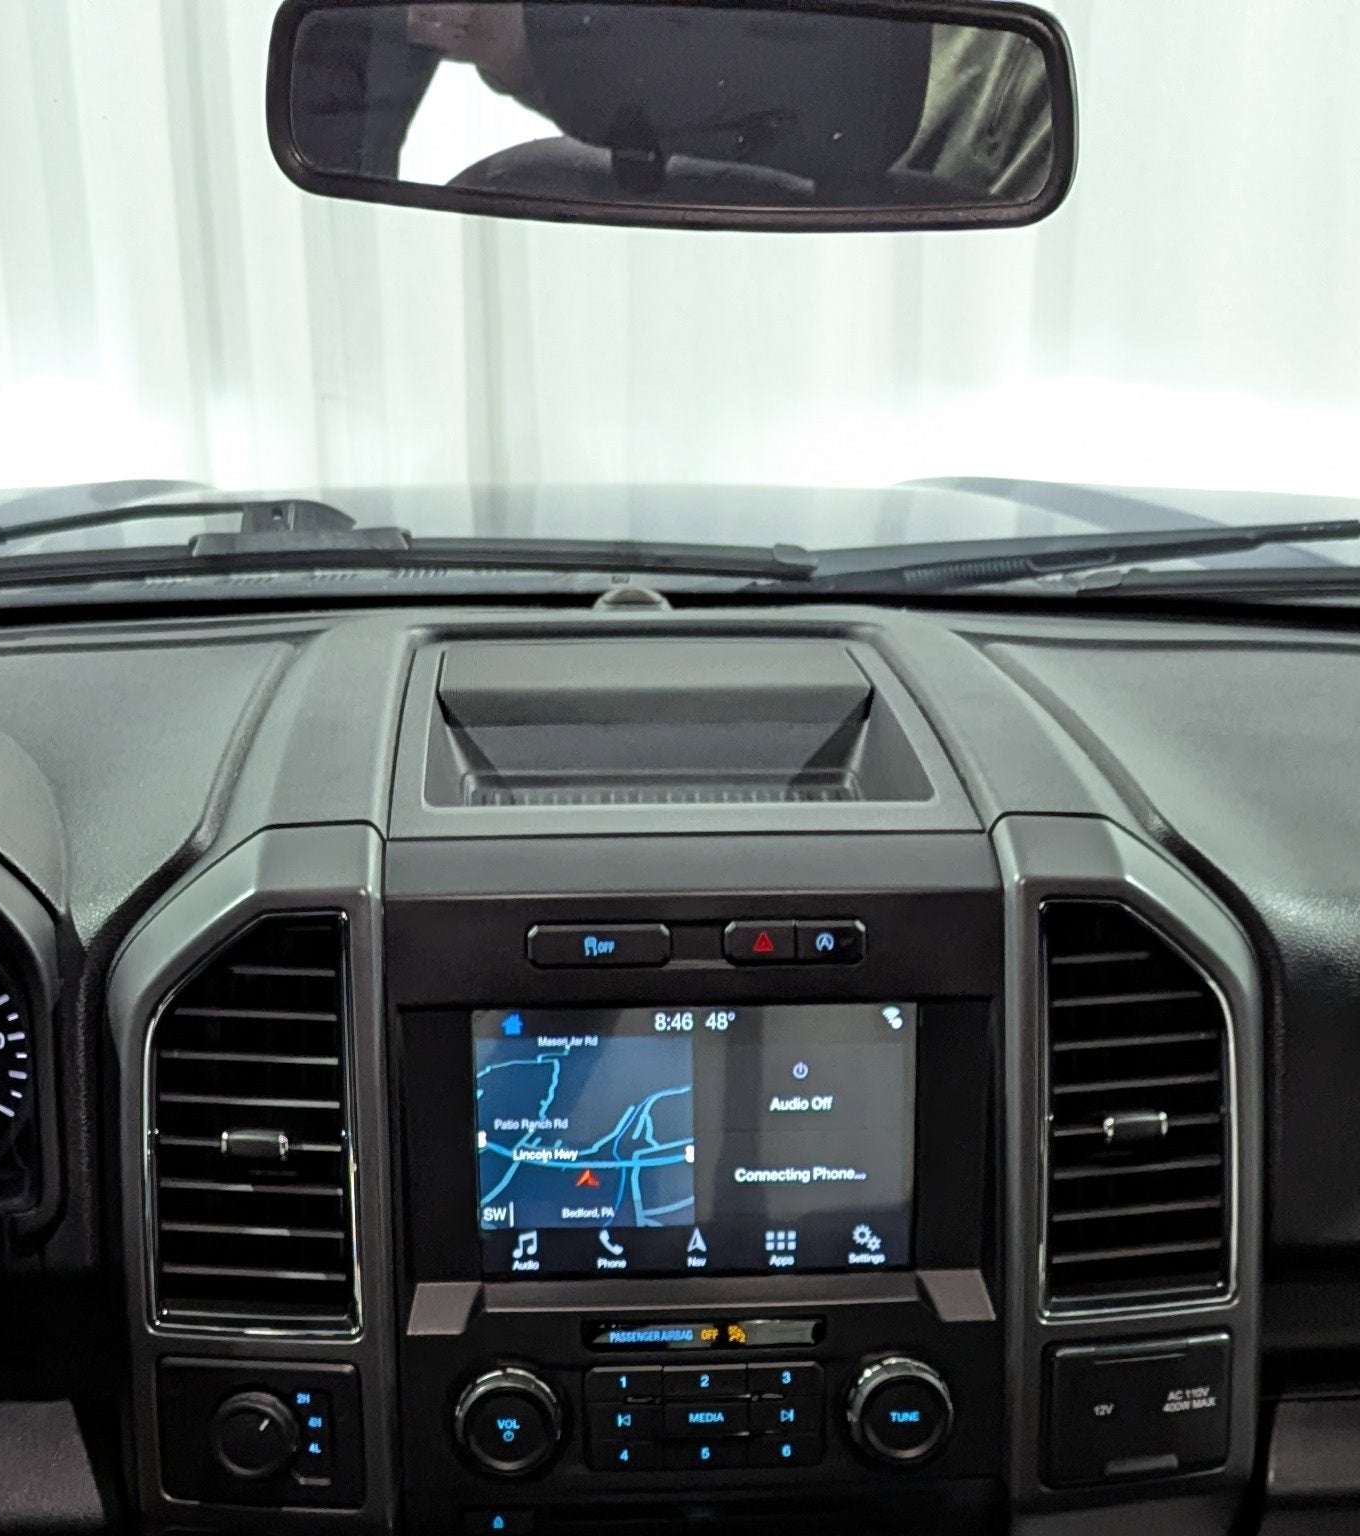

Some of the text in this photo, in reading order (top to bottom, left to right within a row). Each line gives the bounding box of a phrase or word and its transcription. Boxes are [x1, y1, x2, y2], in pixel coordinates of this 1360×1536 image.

[654, 1011, 736, 1032] 8:46 48°
[584, 1036, 599, 1047] Rd
[769, 1096, 834, 1112] Audio Off
[494, 1118, 569, 1130] Patio Ranch Rd
[512, 1149, 580, 1163] Lincoln Hwy
[734, 1166, 867, 1184] Connecting Phone...
[483, 1208, 506, 1222] SW
[562, 1207, 615, 1220] Bedford, PA
[597, 1258, 627, 1269] Phone
[687, 1258, 707, 1268] Nav
[768, 1254, 795, 1268] Apps
[848, 1252, 886, 1265] Settings
[512, 1260, 540, 1272] Audio
[608, 1328, 719, 1344] PASSENGER AIRBAG OFF
[620, 1376, 628, 1388] 1
[700, 1374, 710, 1388] 2
[782, 1371, 792, 1385] 3
[296, 1392, 311, 1404] 2H
[1168, 1389, 1184, 1400] AC
[1192, 1396, 1217, 1409] MAX
[1093, 1403, 1114, 1416] 12V
[688, 1412, 725, 1424] MEDIA
[890, 1411, 920, 1422] TUNE
[497, 1419, 520, 1430] VOL
[619, 1449, 630, 1462] 4
[700, 1447, 710, 1460] 5
[782, 1444, 792, 1458] 6
